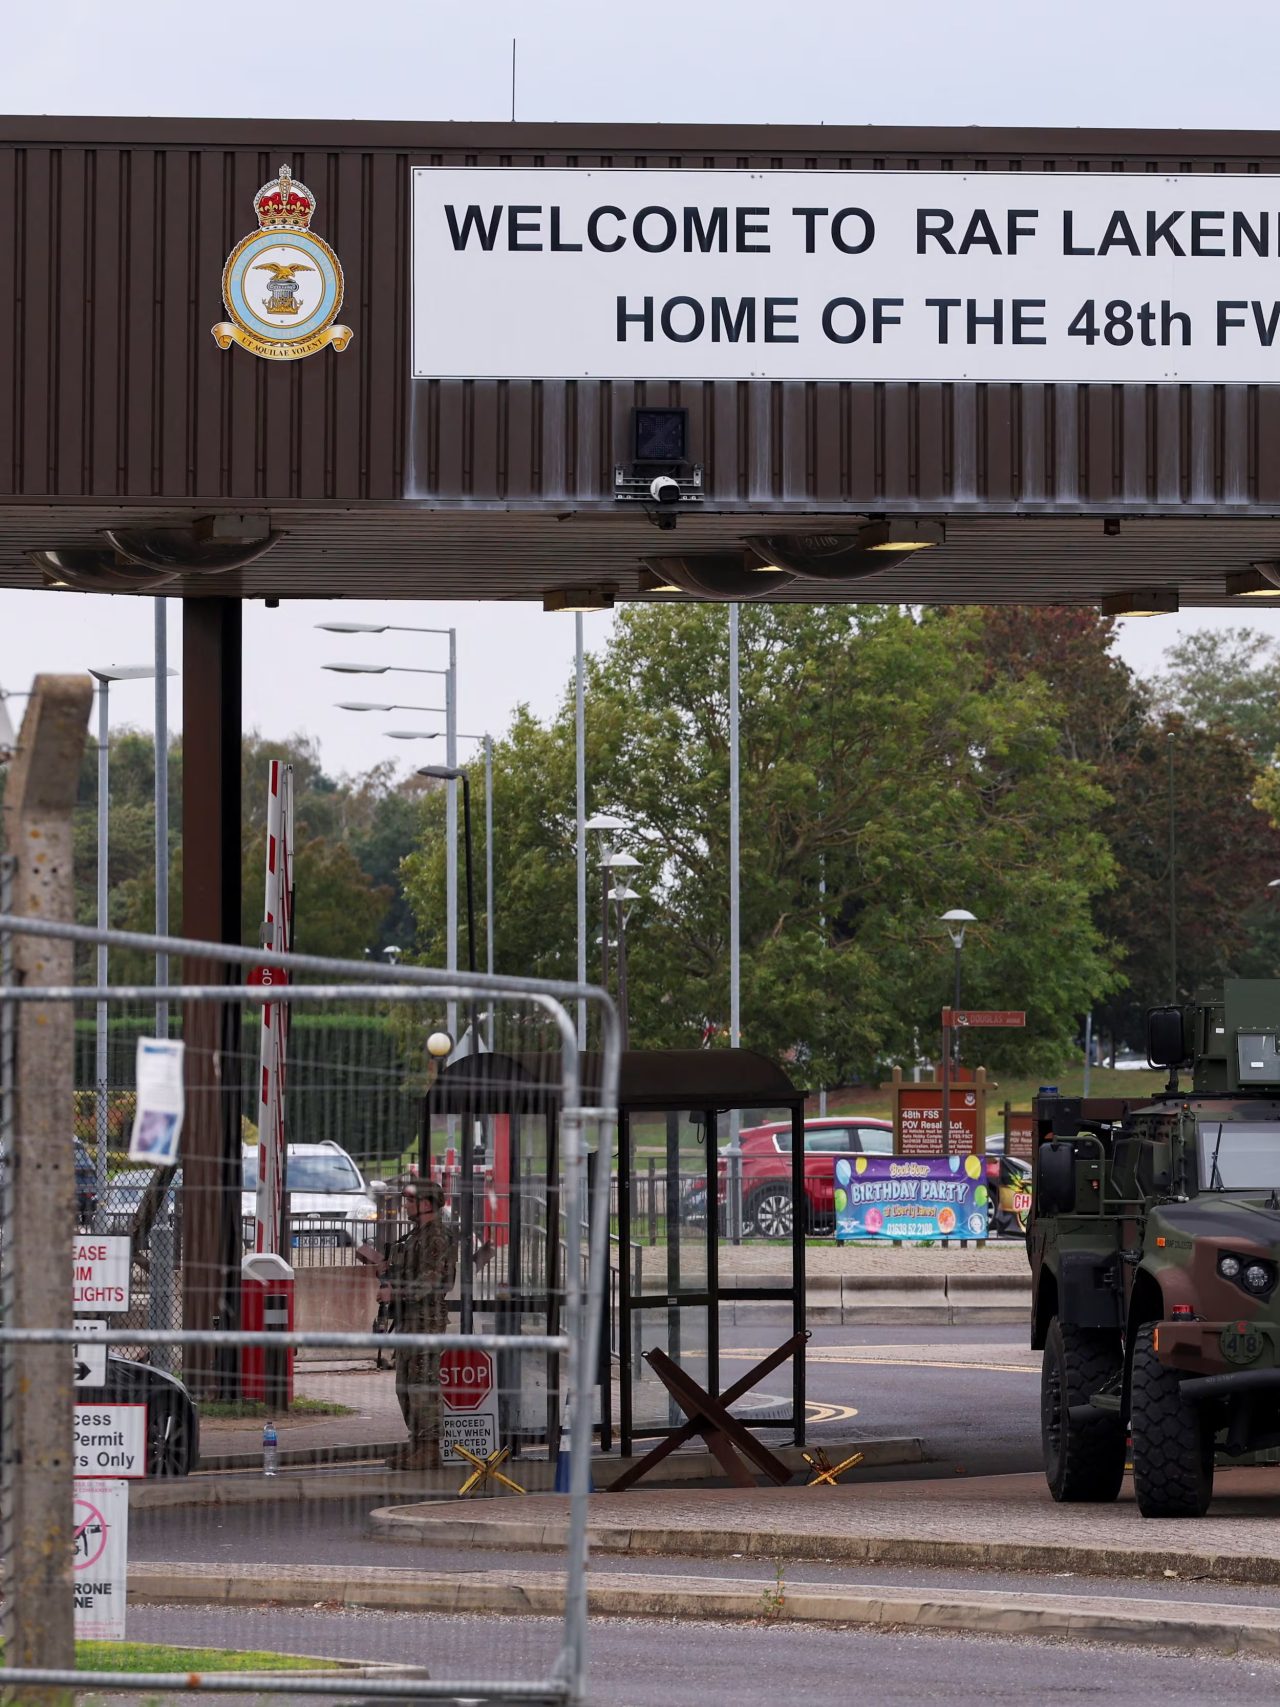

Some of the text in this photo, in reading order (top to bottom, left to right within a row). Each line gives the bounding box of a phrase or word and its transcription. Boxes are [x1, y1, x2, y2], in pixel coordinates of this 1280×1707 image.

[443, 204, 771, 254] WELCOME
[792, 207, 876, 255] TO
[916, 208, 1039, 256] RAF
[616, 295, 800, 344] HOME
[821, 296, 904, 345] OF
[925, 298, 1047, 346] THE
[1067, 299, 1192, 347] 48th
[241, 336, 323, 357] UT AQUILAE VOLENT
[261, 968, 273, 986] OP
[902, 1111, 939, 1119] 48th FSS
[902, 1121, 962, 1130] POV Resal Lot
[889, 1163, 930, 1177] Book Your
[851, 1180, 969, 1205] BIRTHDAY PARTY
[73, 1266, 93, 1281] IM
[73, 1287, 124, 1302] LIGHTS
[439, 1366, 488, 1385] STOP
[73, 1415, 112, 1426] cess
[444, 1419, 485, 1428] PROCEED
[445, 1429, 491, 1438] NLY WHEN
[444, 1449, 454, 1457] BY
[97, 1452, 135, 1469] Only
[74, 1583, 112, 1595] RONE
[74, 1597, 93, 1609] NE
